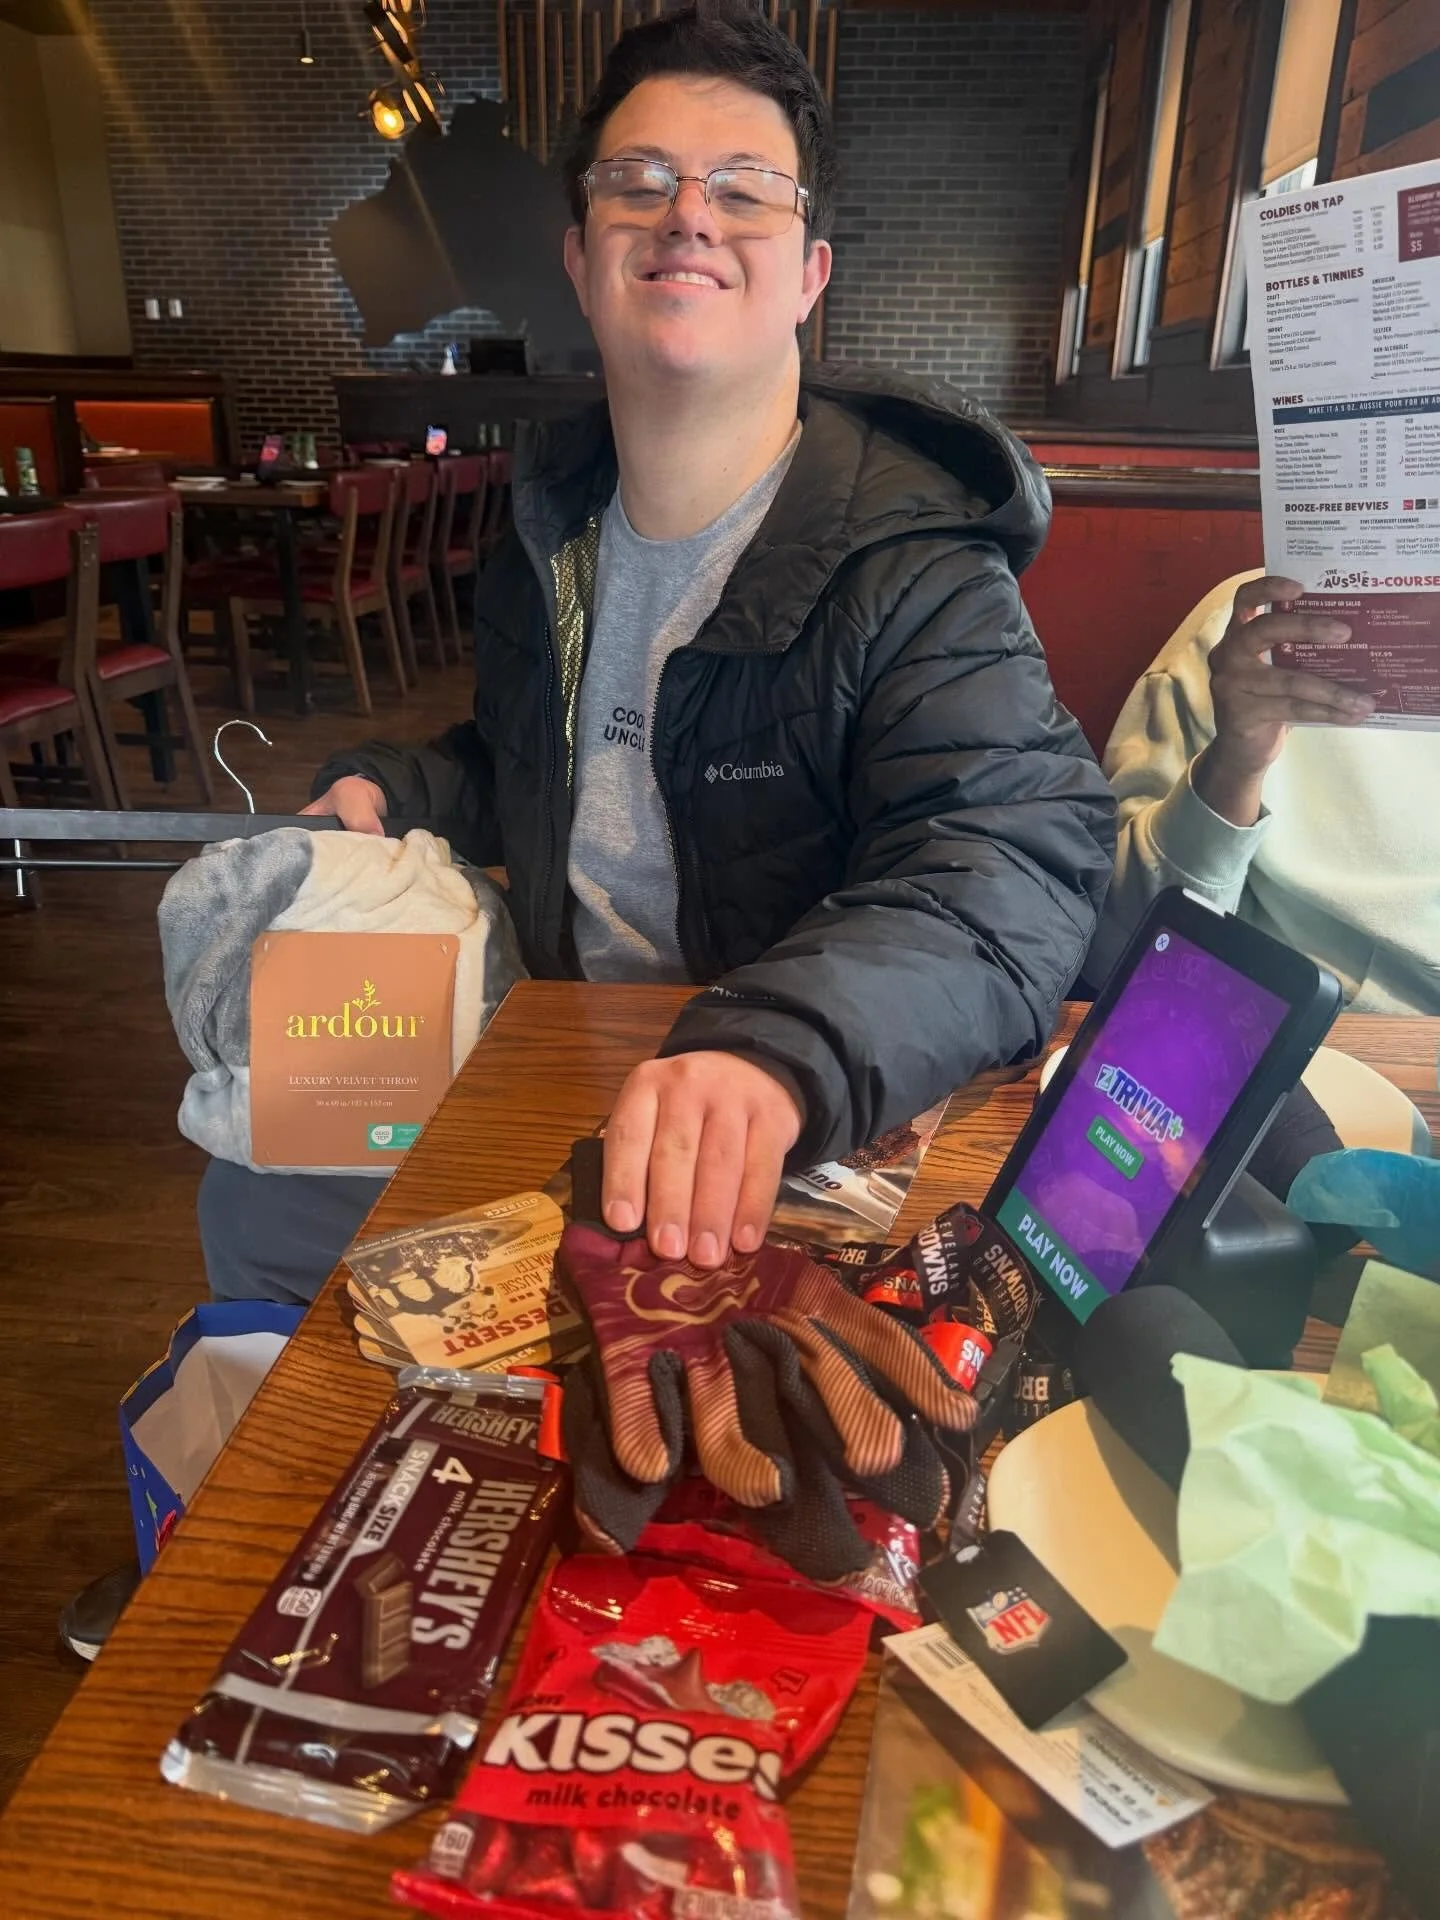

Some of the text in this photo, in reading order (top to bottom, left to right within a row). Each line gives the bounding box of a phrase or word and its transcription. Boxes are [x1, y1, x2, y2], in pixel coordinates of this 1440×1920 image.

[1260, 204, 1302, 221] COLDIES
[1304, 200, 1320, 212] ON
[1322, 195, 1344, 208] TAP
[1410, 240, 1422, 253] $5
[1266, 268, 1364, 292] BOTTLES & TINNIES
[1272, 394, 1304, 406] WINES
[1308, 406, 1325, 415] MAKE
[1360, 400, 1382, 410] AUSSIE
[1384, 399, 1402, 408] POUR
[1285, 501, 1389, 512] BOOZE-FREE BEVVIES
[1324, 572, 1440, 588] AUSSIE 3-COURSE
[1283, 643, 1291, 652] 2
[720, 761, 784, 780] Columbia
[286, 1002, 424, 1038] ardour
[288, 1075, 419, 1085] LUXURY VELVET THROW
[1095, 1126, 1135, 1168] PLAY NOW
[1018, 1213, 1089, 1300] PLAY NOW
[496, 1271, 543, 1296] AUSSIE
[984, 1244, 1029, 1322] BROWNS
[443, 1300, 571, 1357] DESSERT
[432, 1456, 473, 1485] 4
[362, 1449, 430, 1542] SNACK SIZE
[413, 1491, 467, 1572] milk chocolate
[410, 1480, 537, 1649] HERSHEY'S
[990, 1599, 1048, 1645] NFL
[526, 1784, 742, 1820] milk chocolate
